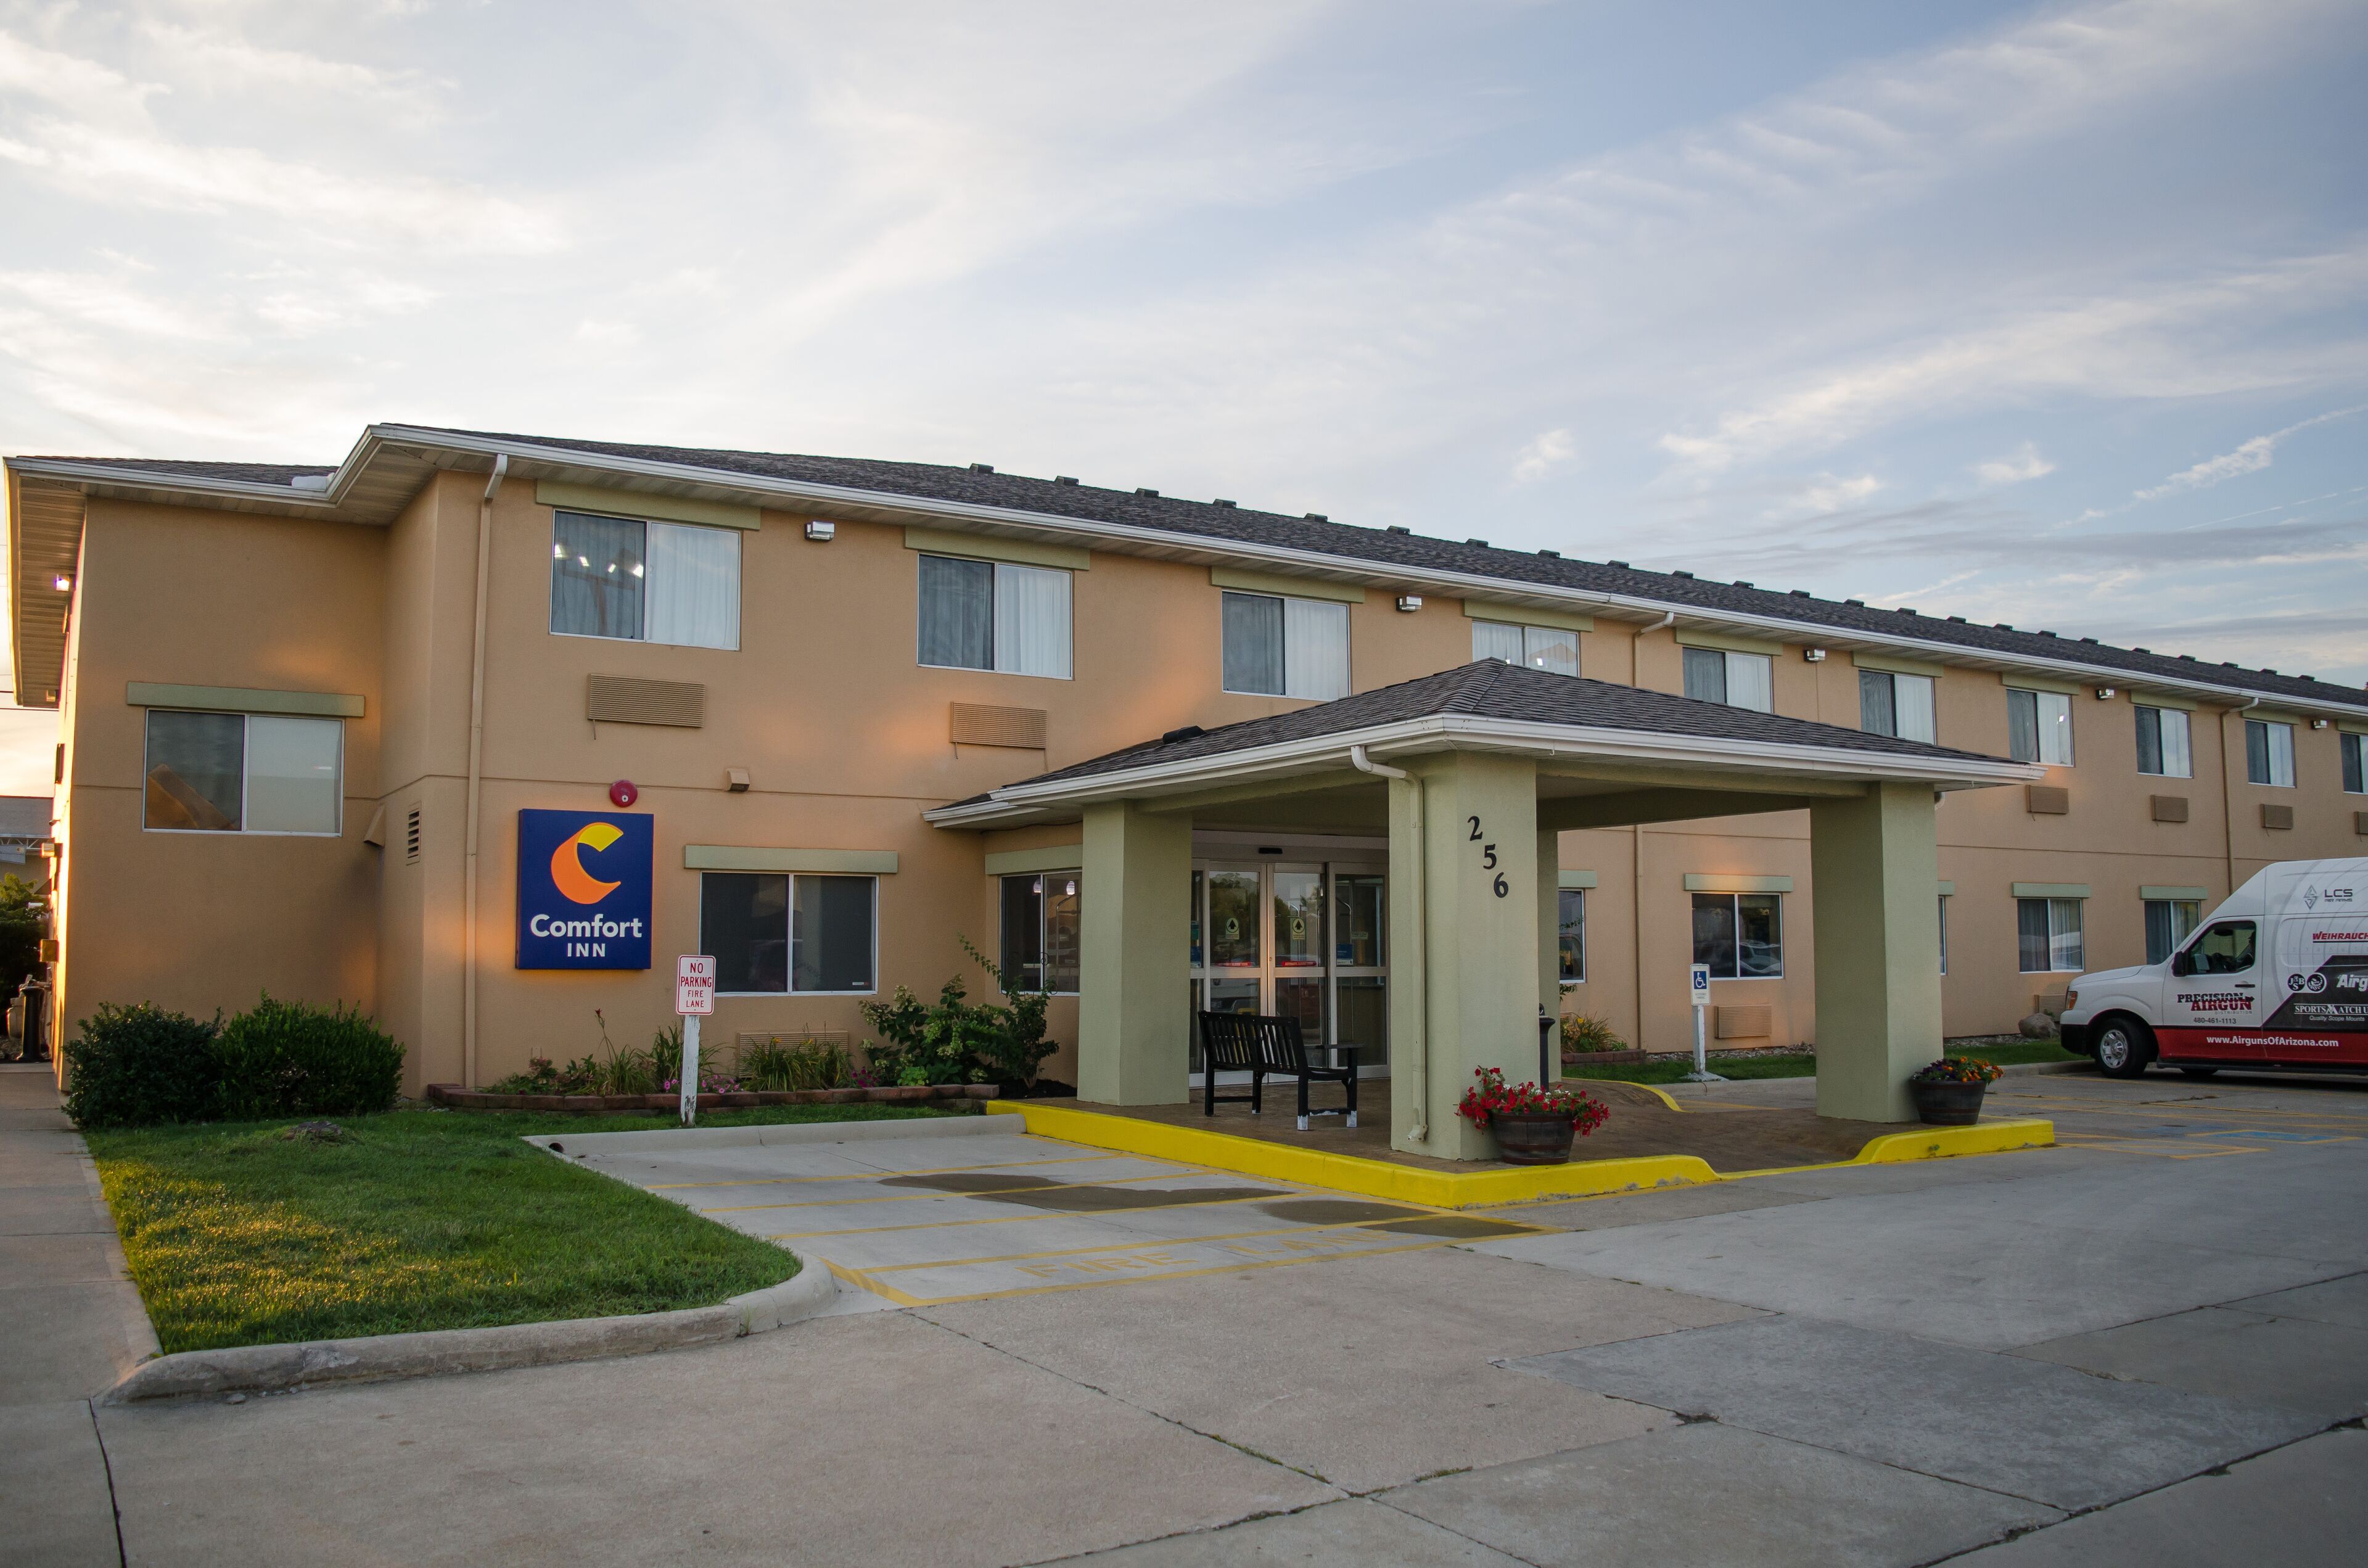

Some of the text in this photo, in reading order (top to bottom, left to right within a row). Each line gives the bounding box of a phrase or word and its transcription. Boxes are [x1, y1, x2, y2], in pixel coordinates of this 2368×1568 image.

[2324, 889, 2353, 898] LCS
[530, 913, 643, 938] Comfort
[567, 943, 606, 957] INN
[690, 963, 704, 974] NO
[680, 976, 712, 988] PARKING
[2336, 974, 2368, 992] Airg
[688, 990, 704, 998] FIRE
[2177, 993, 2245, 1003] PRECISION
[686, 1000, 704, 1008] LANE
[2191, 999, 2252, 1011] AIRGUN
[2206, 1036, 2339, 1047] www.AirgunsOfArizona.com
